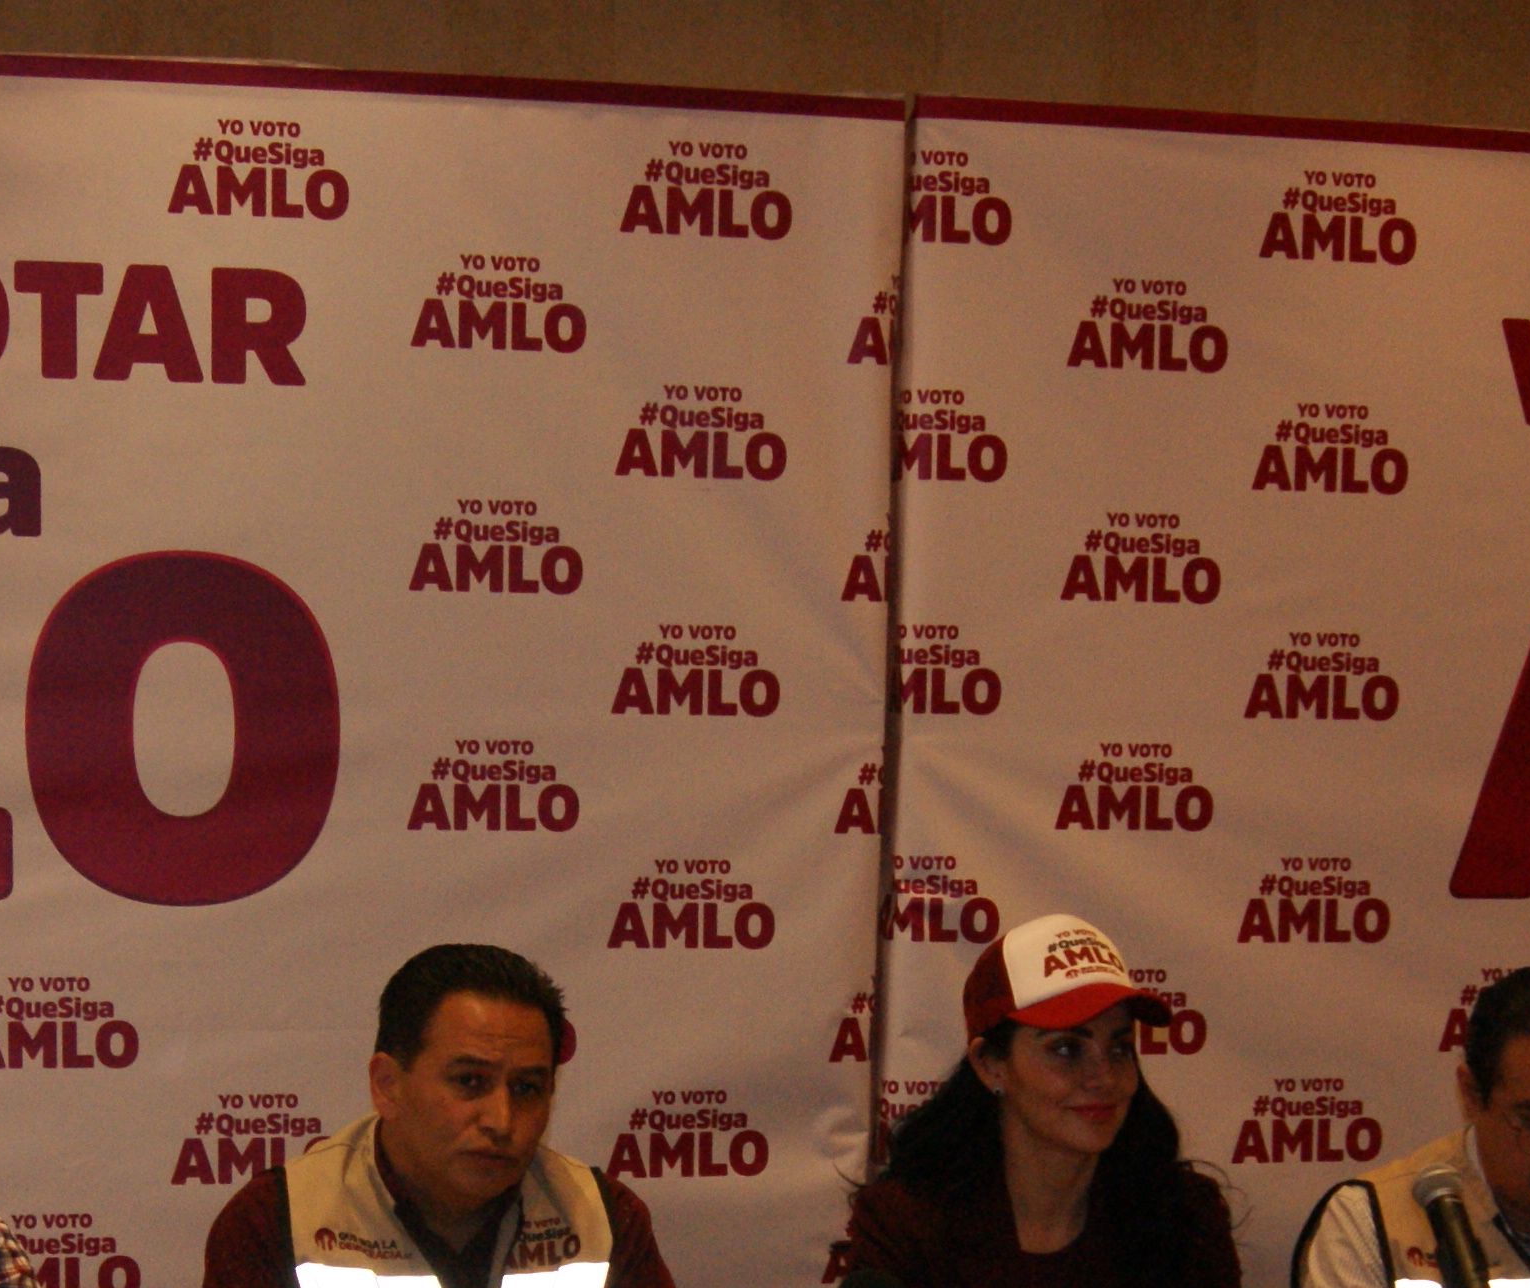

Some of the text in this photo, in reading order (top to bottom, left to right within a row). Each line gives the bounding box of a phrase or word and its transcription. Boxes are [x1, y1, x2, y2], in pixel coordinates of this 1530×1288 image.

[669, 141, 747, 160] YO VOTO
[645, 159, 770, 190] #QueSiga
[1304, 171, 1376, 189] YO VOTO
[619, 184, 793, 241] AMLO
[1282, 187, 1396, 218] #QueSiga
[1259, 212, 1417, 266] AMLO
[1113, 279, 1187, 296] YO VOTO
[1090, 295, 1207, 326] #QueSiga
[1067, 320, 1228, 374] AMLO
[458, 499, 537, 516] YO VOTO
[434, 517, 560, 546] #QueSiga
[409, 543, 583, 595] AMLO
[1289, 632, 1360, 648] YO VOTO
[1267, 649, 1380, 676] #QueSiga
[1244, 673, 1400, 722] AMLO
[1043, 946, 1125, 977] AMLO
[8, 977, 90, 992] YO VOTO
[651, 1090, 727, 1105] YO VOTO
[1274, 1078, 1344, 1092] YO VOTO
[629, 1108, 748, 1133] #QueSiga
[1253, 1095, 1363, 1120] #QueSiga
[606, 1129, 769, 1179] AMLO
[1231, 1118, 1383, 1164] AMLO
[518, 1226, 571, 1244] QueSiga
